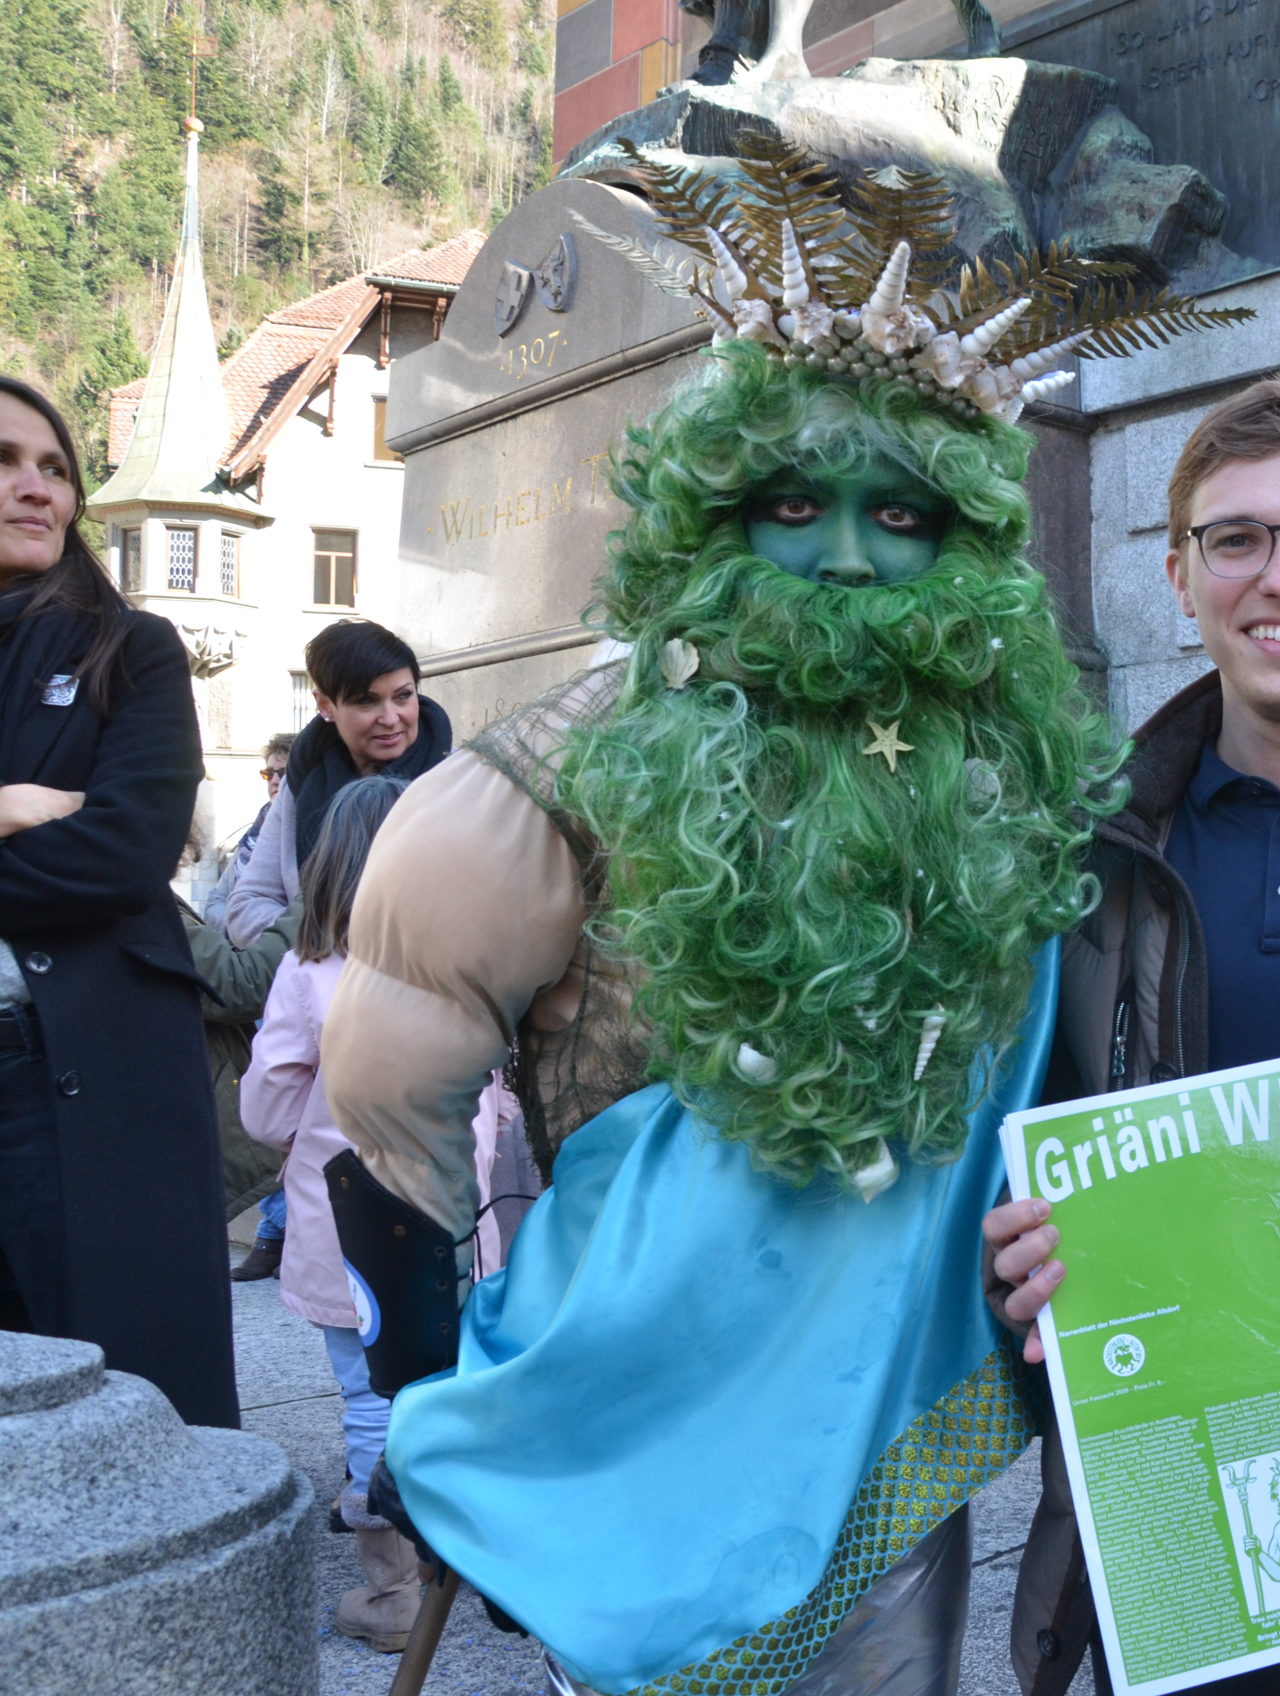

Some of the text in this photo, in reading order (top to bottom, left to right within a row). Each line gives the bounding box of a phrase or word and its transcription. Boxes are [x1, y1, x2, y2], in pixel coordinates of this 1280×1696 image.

[508, 329, 560, 380] 1307
[1035, 1092, 1200, 1203] Griäni
[1058, 1324, 1096, 1337] Narrenblatt
[1109, 1311, 1155, 1326] Nächstenliebe
[1156, 1305, 1180, 1315] Altdorf
